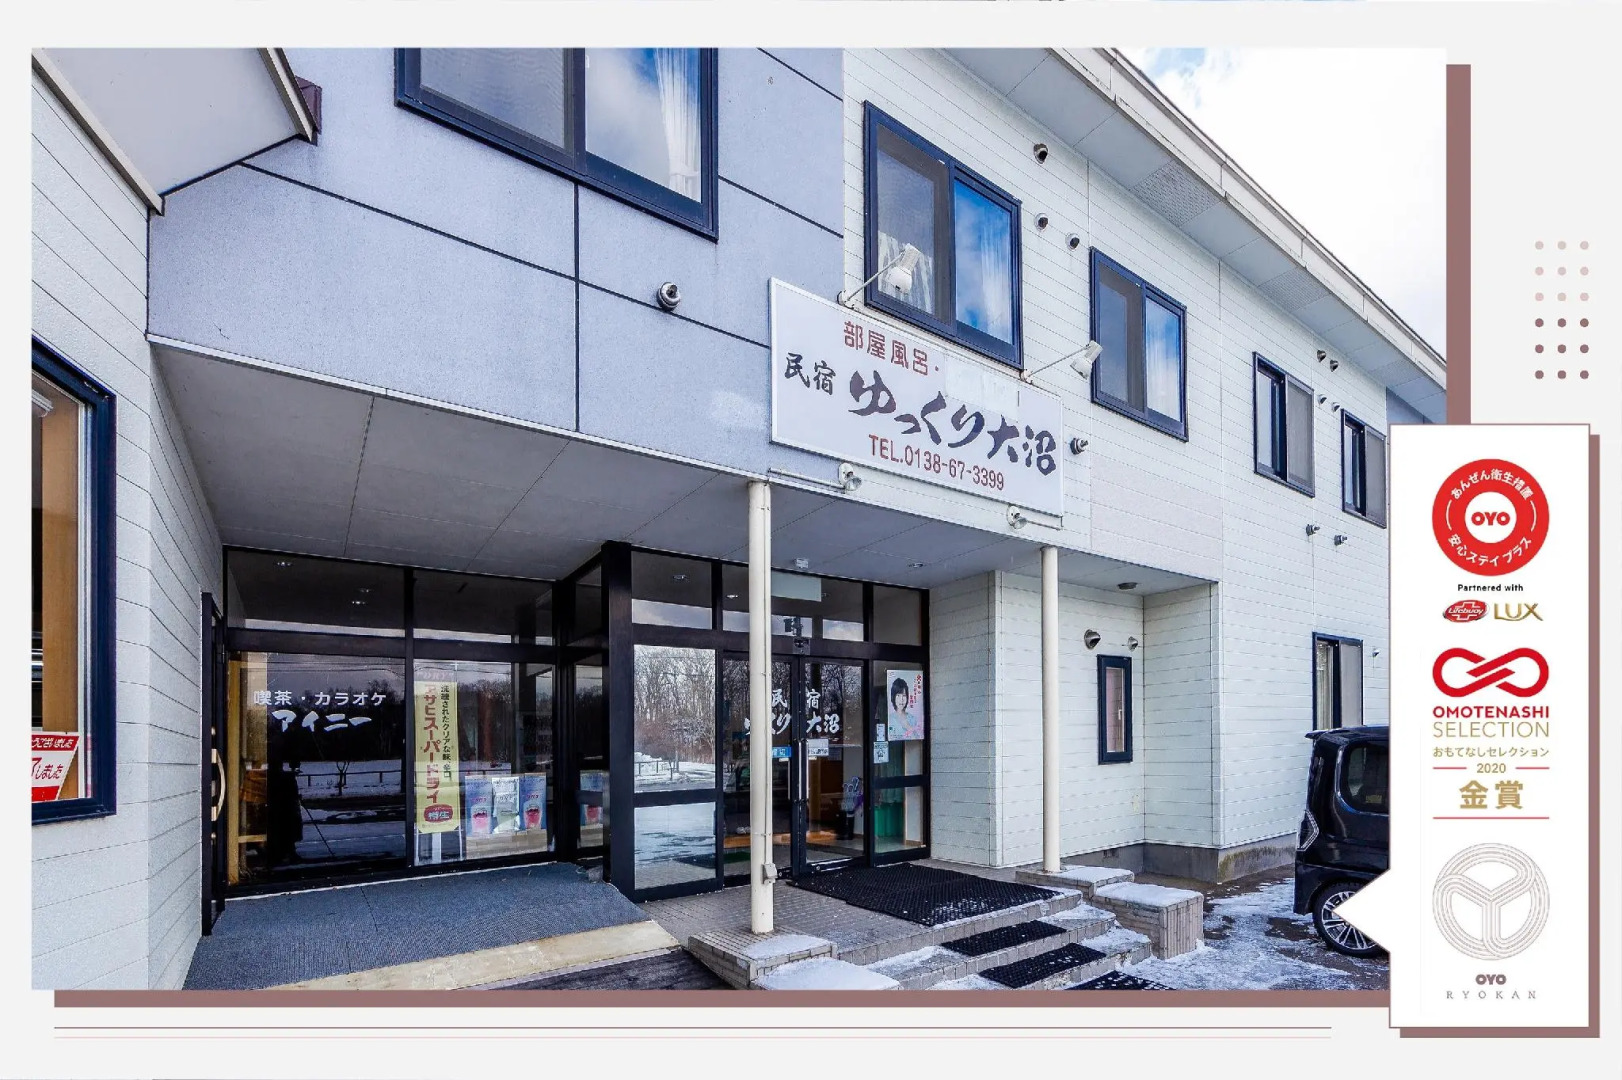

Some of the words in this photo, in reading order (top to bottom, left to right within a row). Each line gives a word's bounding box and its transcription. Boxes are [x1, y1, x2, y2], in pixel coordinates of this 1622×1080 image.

[784, 352, 836, 396] 民宿
[848, 369, 1057, 476] ゆっくり大沼
[868, 434, 1005, 491] TEL.0138-67-3399
[253, 689, 387, 706] 喫茶・カラオケ
[271, 709, 373, 733] アイニー
[423, 684, 441, 804] アサヒスーパードライ
